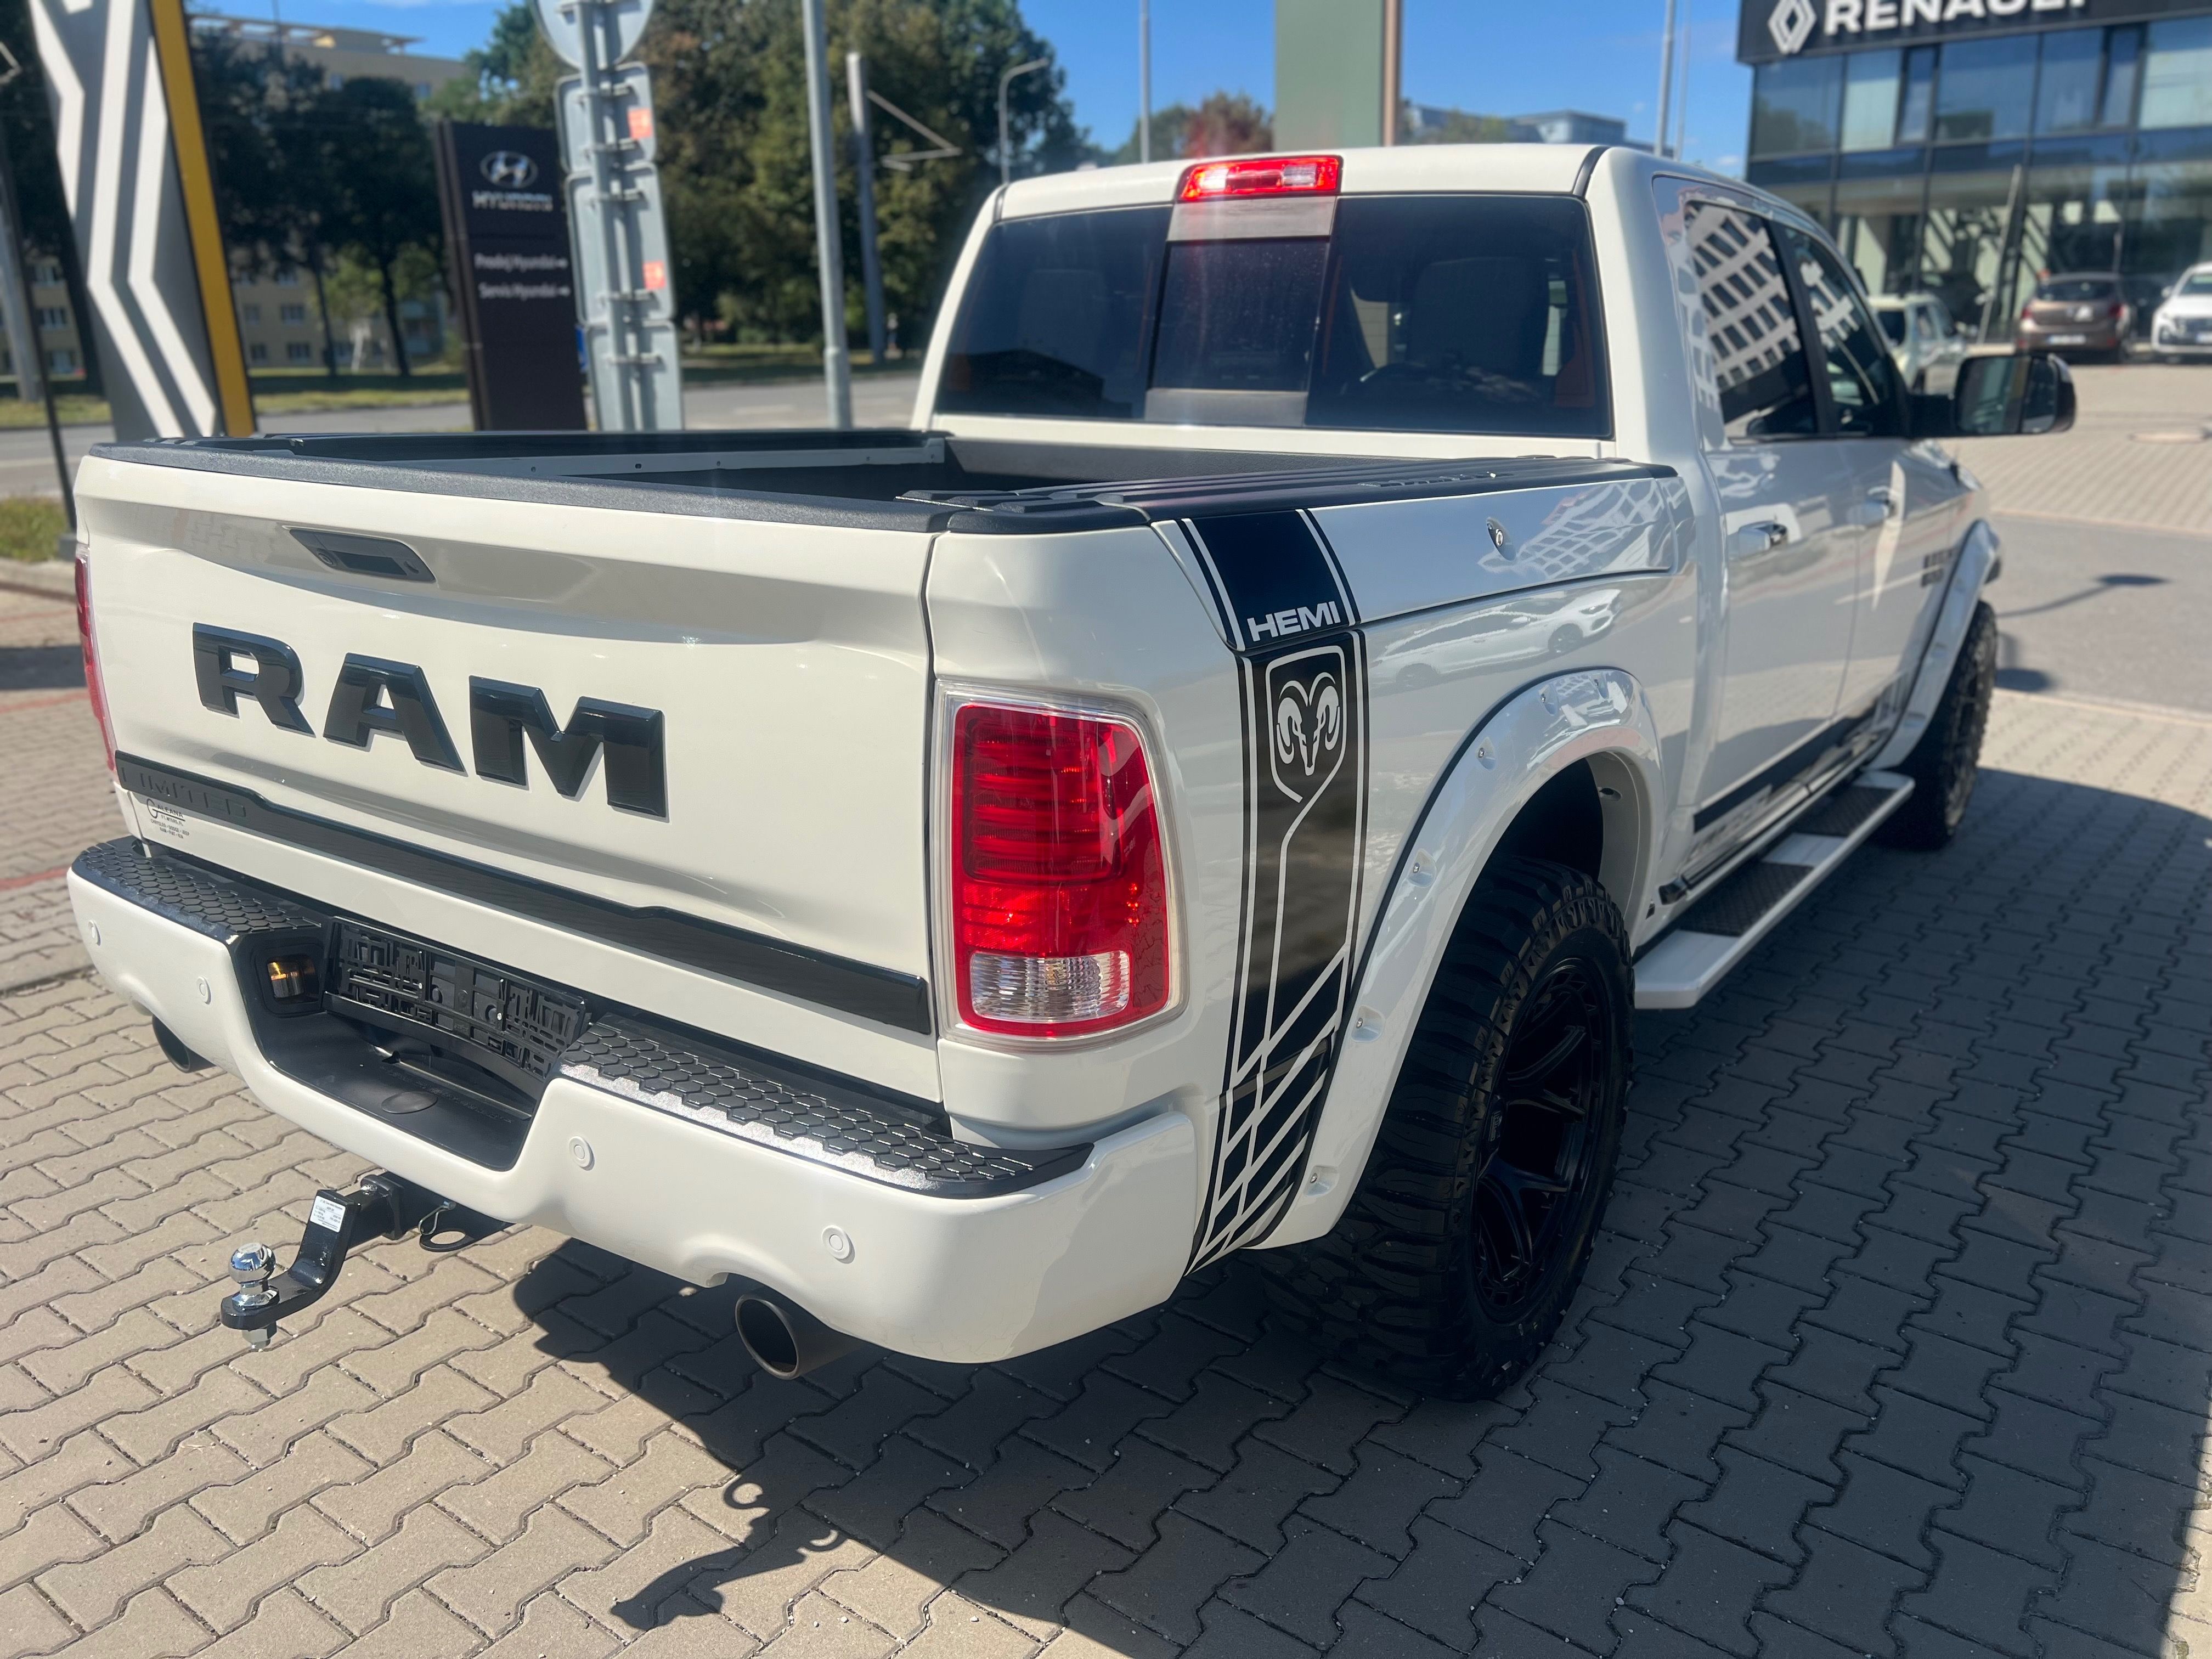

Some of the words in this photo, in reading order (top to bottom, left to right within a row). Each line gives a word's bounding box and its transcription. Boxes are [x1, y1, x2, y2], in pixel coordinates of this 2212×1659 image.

[1824, 0, 2086, 35] RENA
[1248, 601, 1342, 642] HEMI
[193, 622, 667, 818] RAM
